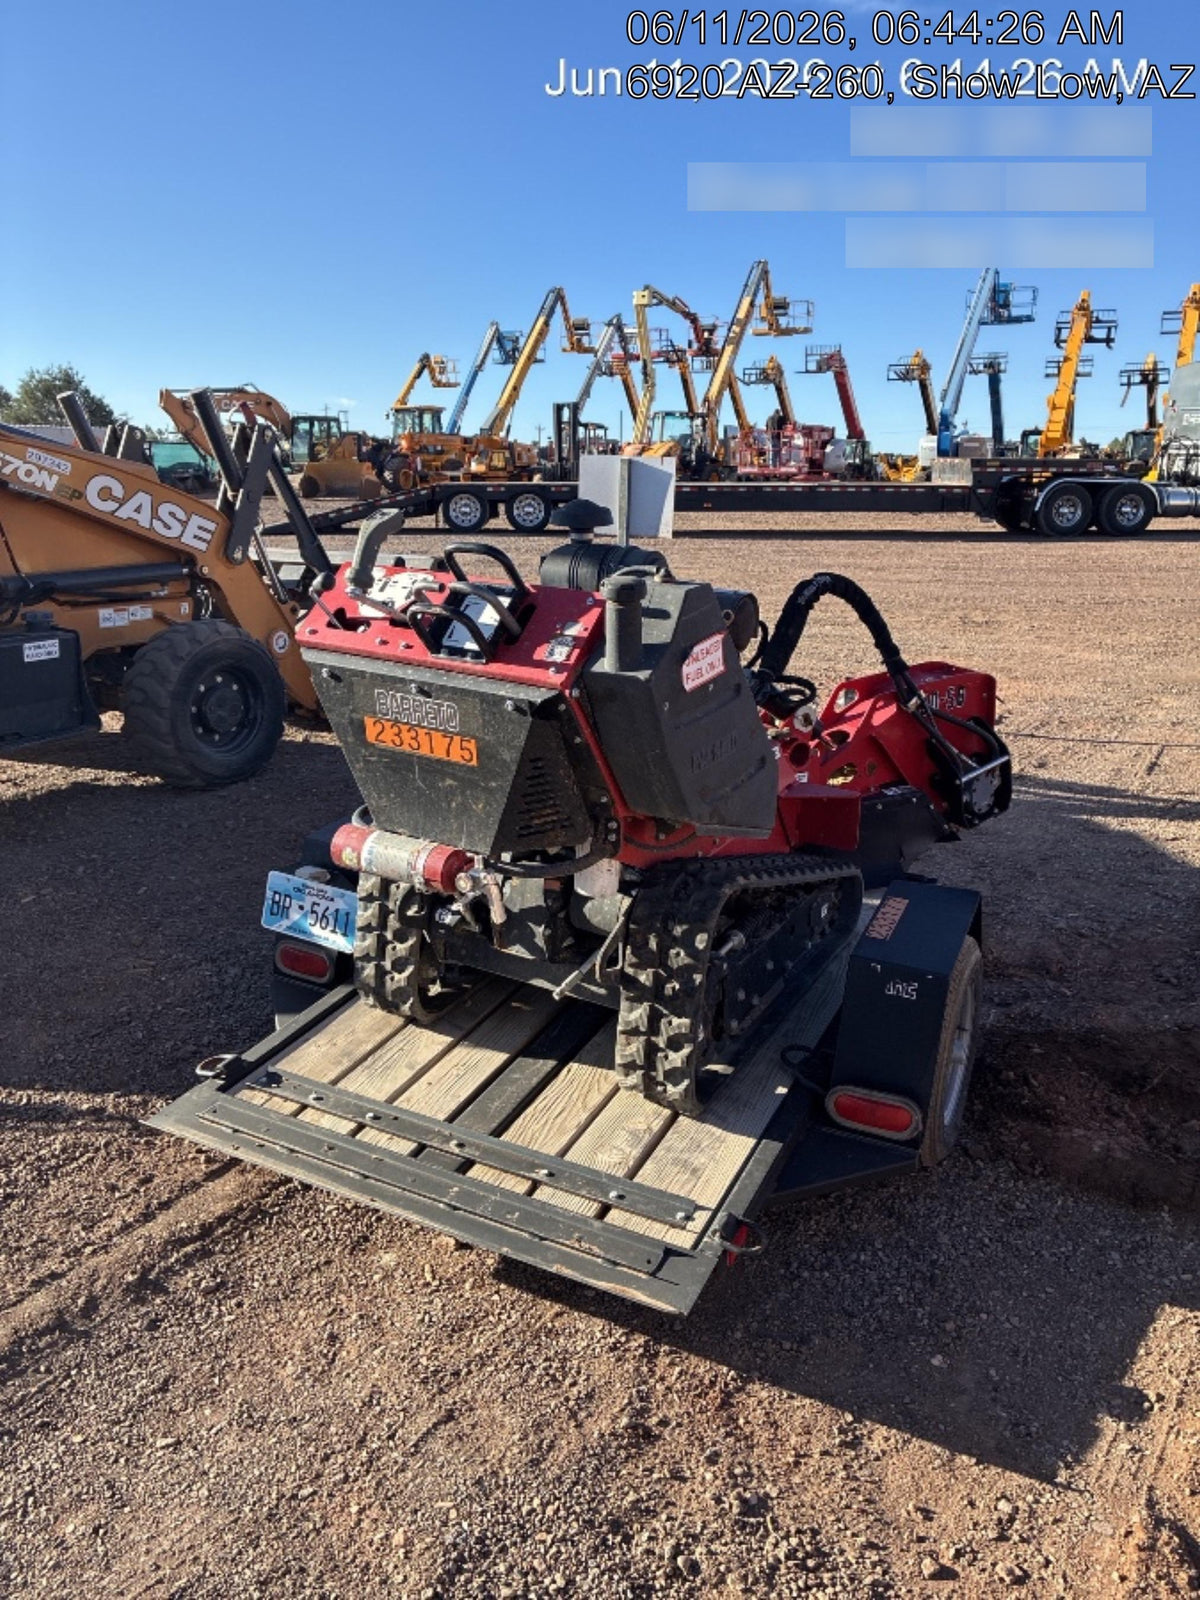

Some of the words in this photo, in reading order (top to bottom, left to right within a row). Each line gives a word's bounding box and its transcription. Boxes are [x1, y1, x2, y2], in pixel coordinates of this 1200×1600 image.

[0, 451, 60, 492] 70N
[85, 474, 218, 552] CASE
[374, 689, 460, 732] BARRETO
[372, 719, 474, 763] 233175
[269, 890, 292, 920] BR
[308, 900, 351, 938] 5611
